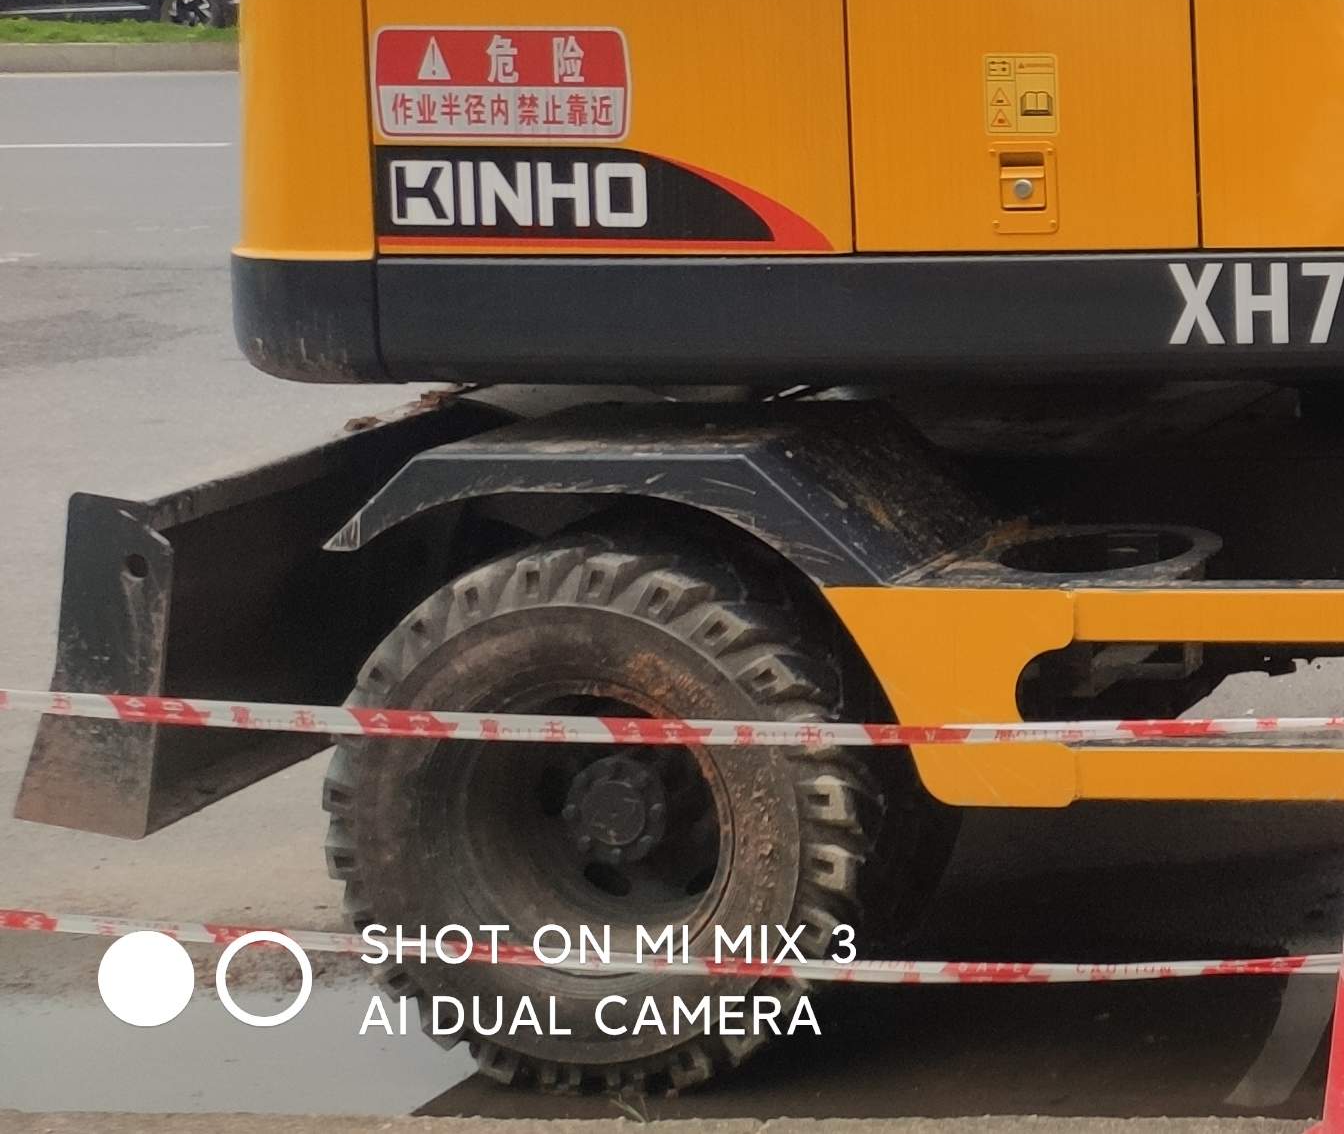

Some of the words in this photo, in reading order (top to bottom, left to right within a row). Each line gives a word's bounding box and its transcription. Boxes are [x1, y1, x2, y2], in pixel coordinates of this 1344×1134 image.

[486, 34, 586, 84] 危险
[391, 92, 615, 128] 作业半径内禁止靠近
[389, 160, 649, 229] KINHO
